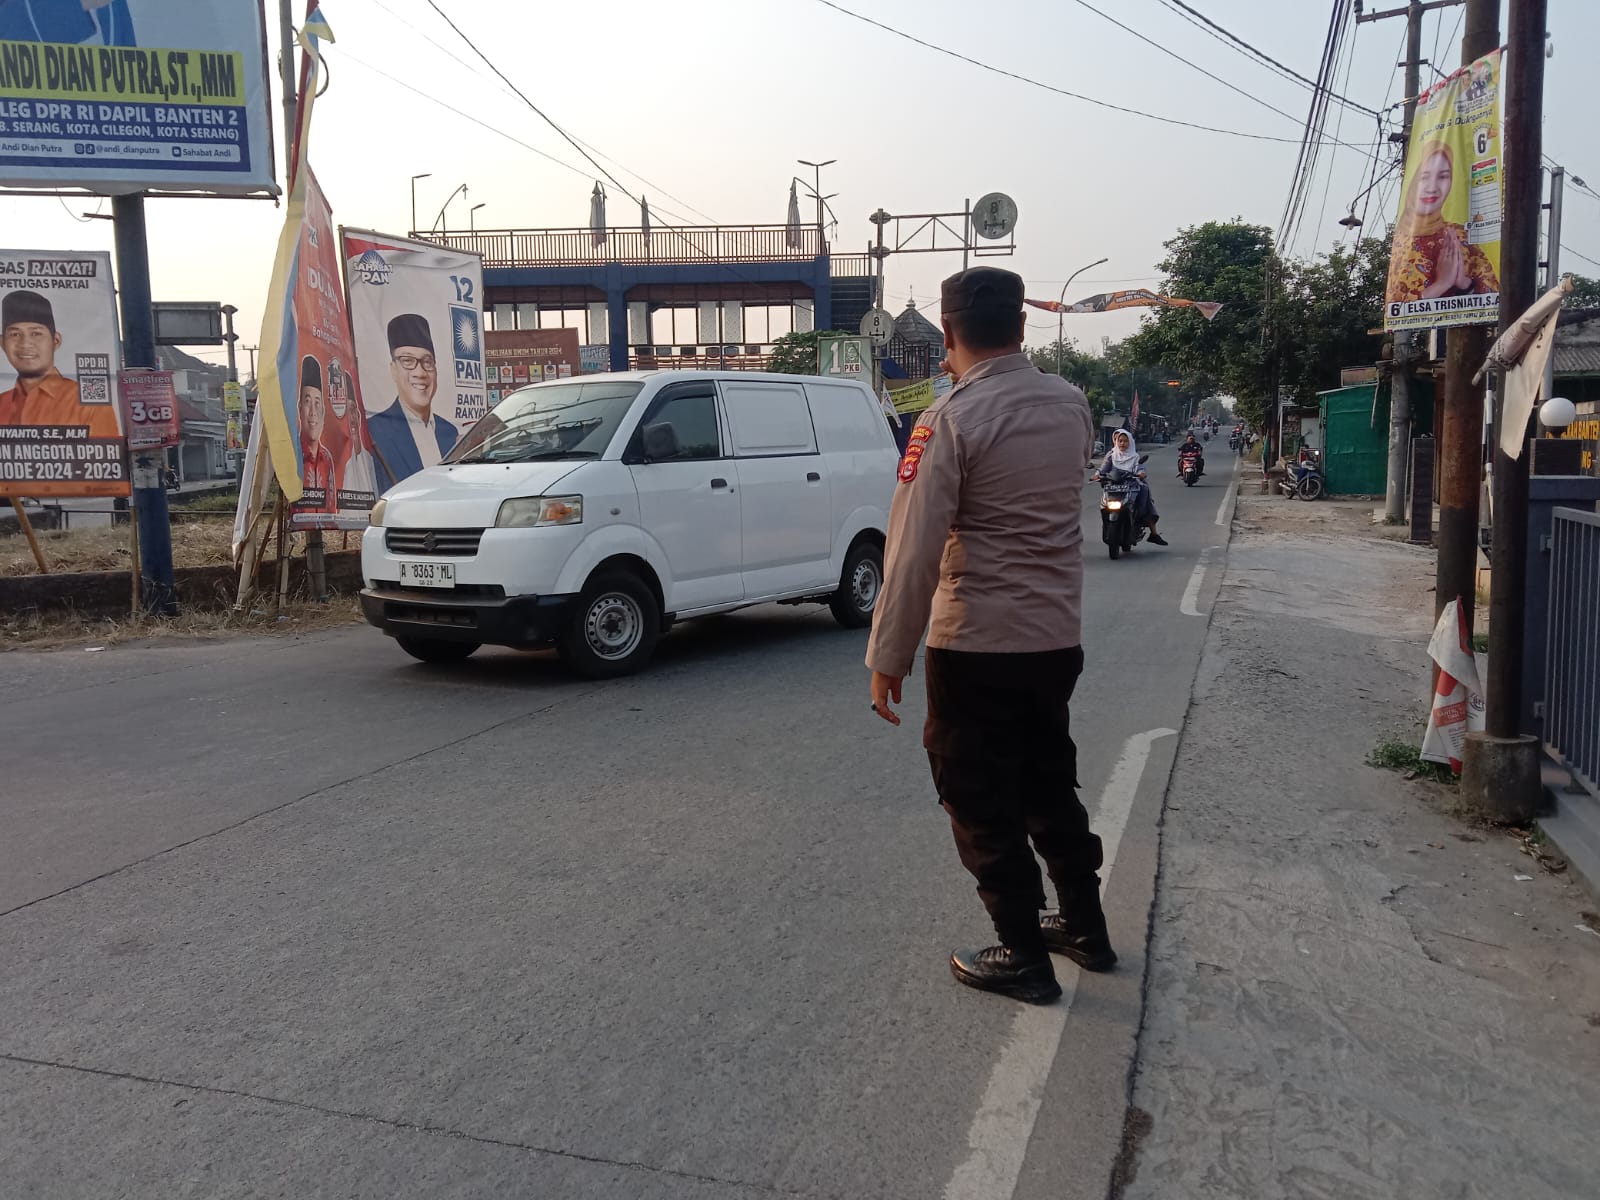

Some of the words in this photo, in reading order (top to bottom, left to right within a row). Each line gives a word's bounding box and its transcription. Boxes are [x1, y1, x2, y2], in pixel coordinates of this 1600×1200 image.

[44, 45, 96, 92] DIAN
[35, 102, 72, 120] DPR
[76, 104, 94, 121] RI
[99, 105, 151, 123] DAPIL
[154, 107, 224, 125] BANTEN
[228, 110, 238, 125] 2
[12, 121, 64, 135] SERANG,
[66, 123, 99, 135] KOTA
[101, 124, 154, 138] CILEGON,
[157, 126, 189, 138] KOTA
[190, 127, 239, 141] SERANG)
[1, 143, 20, 151] Andi
[21, 143, 40, 152] Dian
[40, 144, 63, 152] Putra
[1477, 133, 1487, 154] 6
[182, 148, 212, 157] Sahabat
[213, 149, 231, 157] Andi
[31, 262, 93, 275] RAKYAT!
[353, 262, 393, 273] SAHABAT
[0, 278, 50, 289] PETUGAS
[51, 279, 89, 289] PARTAI
[361, 271, 389, 283] PAN
[450, 276, 474, 303] 12
[1390, 303, 1401, 317] 6
[1407, 303, 1432, 314] ELSA
[873, 316, 880, 327] 8
[78, 357, 96, 368] DPD
[97, 357, 107, 368] RI
[830, 341, 841, 374] 1
[844, 364, 860, 372] PKB
[455, 362, 482, 380] PAN
[122, 375, 170, 384] smartfren
[457, 393, 484, 406] BANTU
[43, 428, 63, 439] S.E.,
[66, 428, 87, 439] M.M
[14, 444, 76, 460] ANGGOTA
[77, 444, 103, 460] DPD
[106, 444, 120, 460] RI
[35, 462, 72, 479] 2024
[84, 462, 122, 479] 2029
[401, 564, 406, 578] A
[413, 564, 434, 578] 8363
